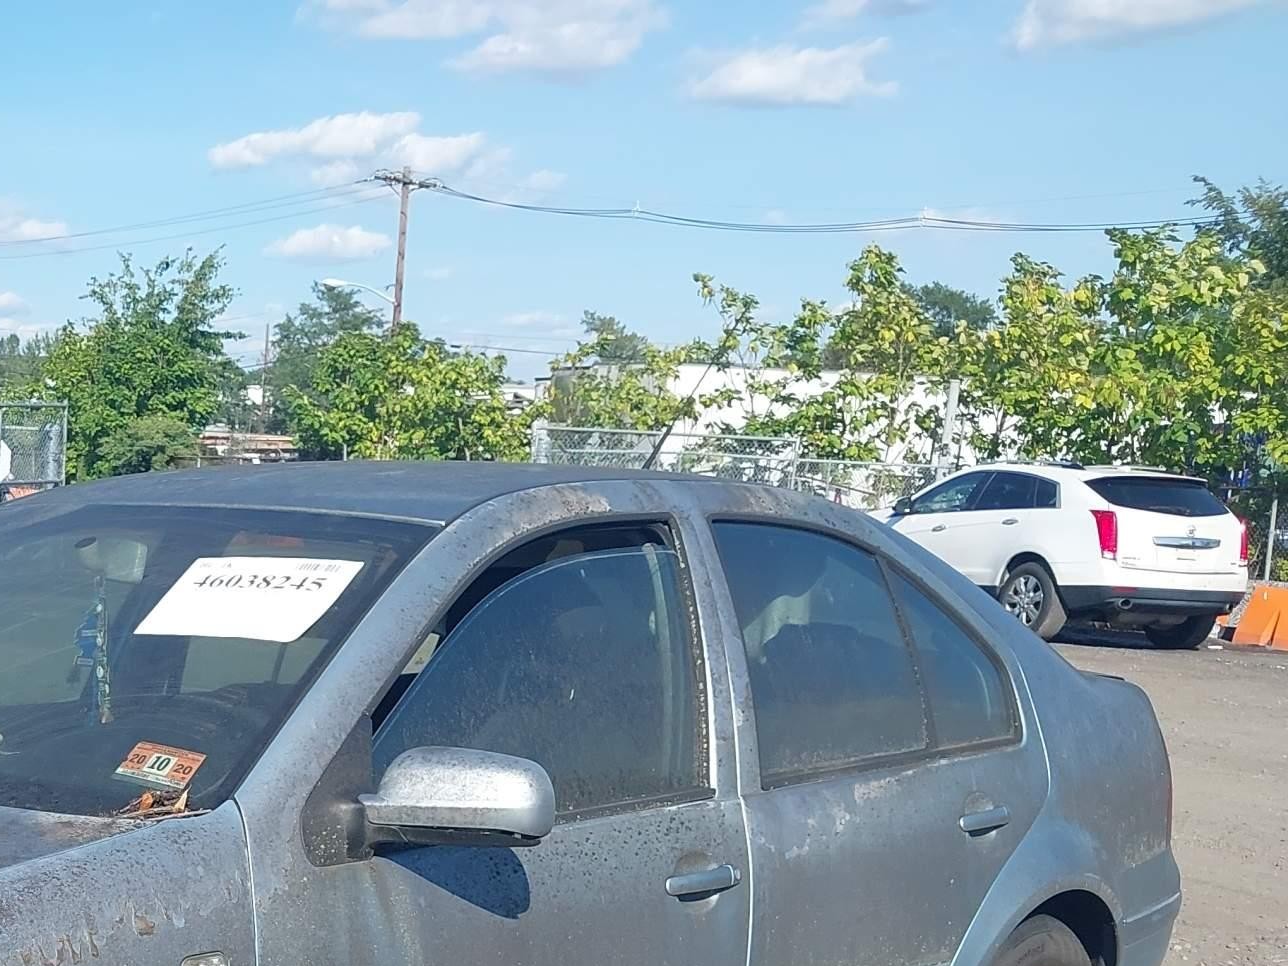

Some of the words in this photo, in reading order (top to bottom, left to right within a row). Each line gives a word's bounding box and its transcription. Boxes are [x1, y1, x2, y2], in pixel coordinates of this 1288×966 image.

[194, 573, 328, 592] 46038245
[129, 753, 147, 765] 20
[148, 755, 171, 772] 10
[173, 763, 193, 775] 20
